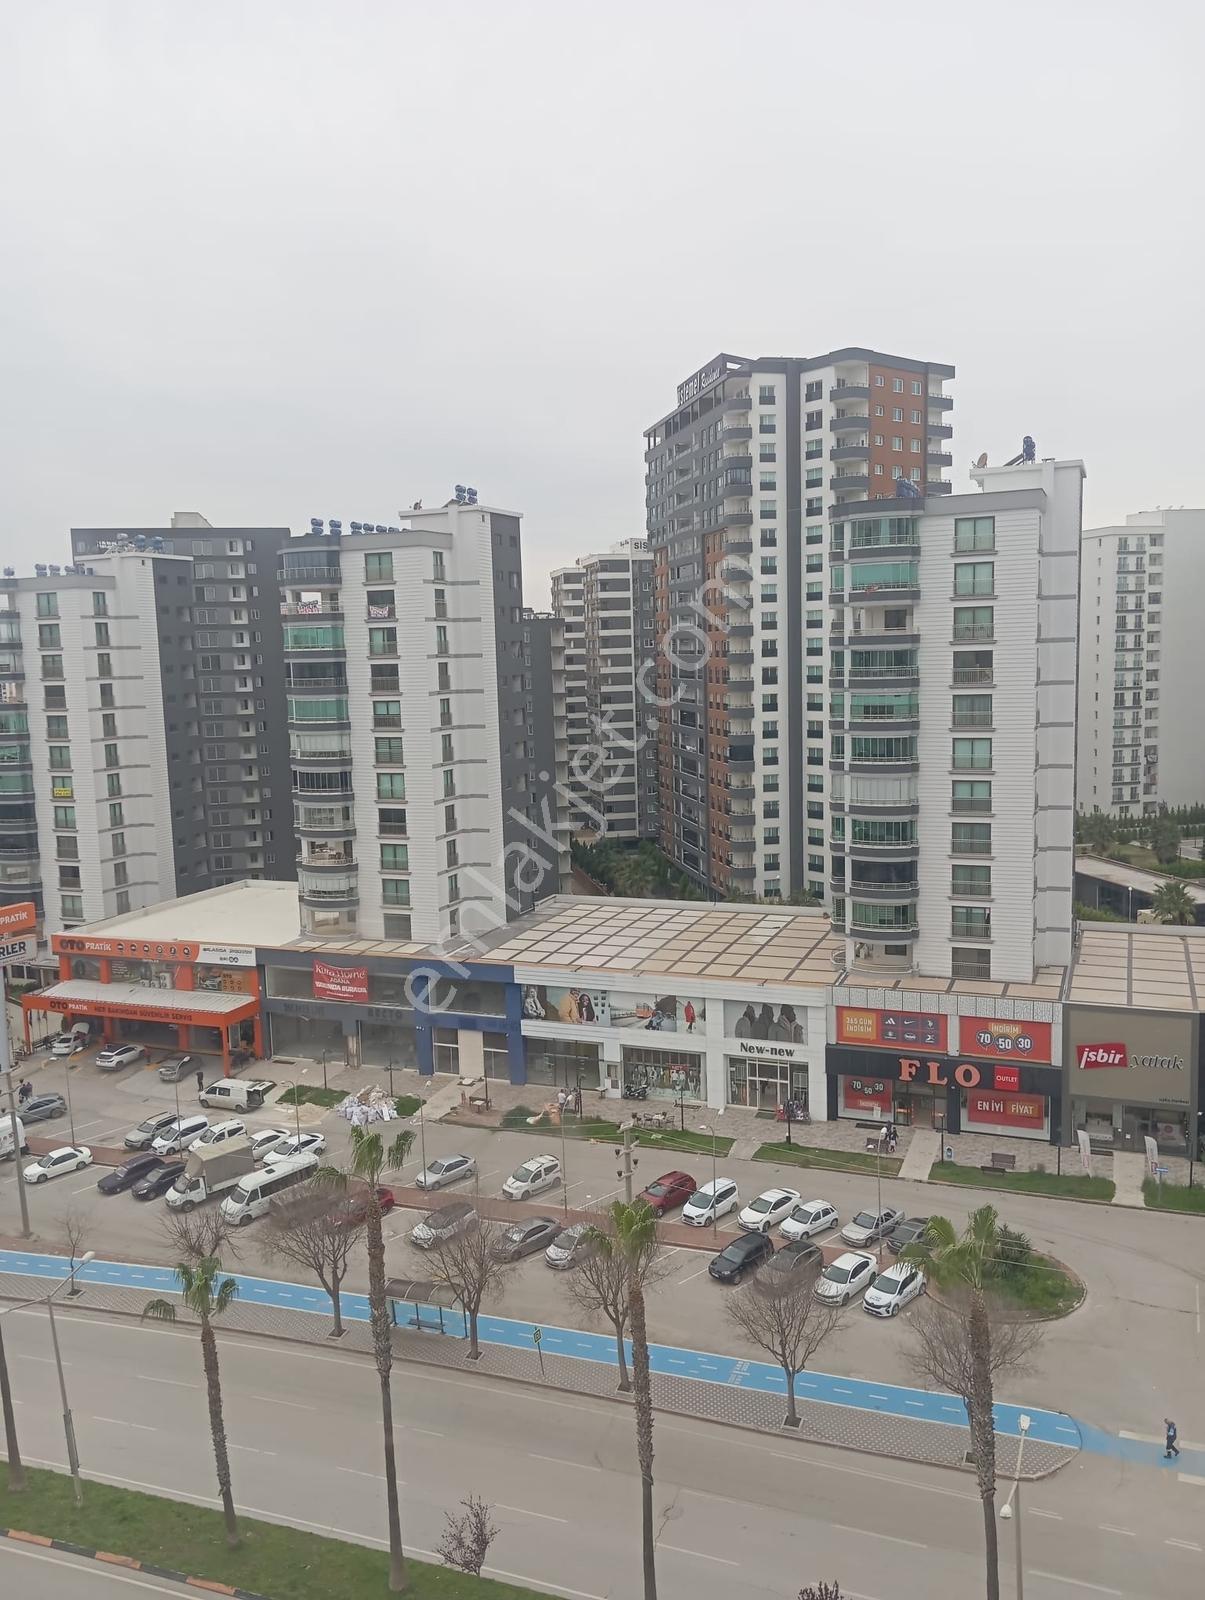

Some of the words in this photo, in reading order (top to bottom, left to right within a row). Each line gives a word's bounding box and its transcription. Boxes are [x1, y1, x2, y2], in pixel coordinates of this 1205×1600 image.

[60, 939, 85, 952] OTO
[85, 942, 112, 951] PRATİK
[50, 1001, 68, 1010] OTO
[740, 1042, 795, 1057] New-new
[898, 1058, 981, 1088] FLO
[996, 1075, 1017, 1083] OUTLET
[977, 1101, 989, 1112] EN
[991, 1100, 1004, 1113] İYİ
[1011, 1103, 1034, 1115] FİYAT
